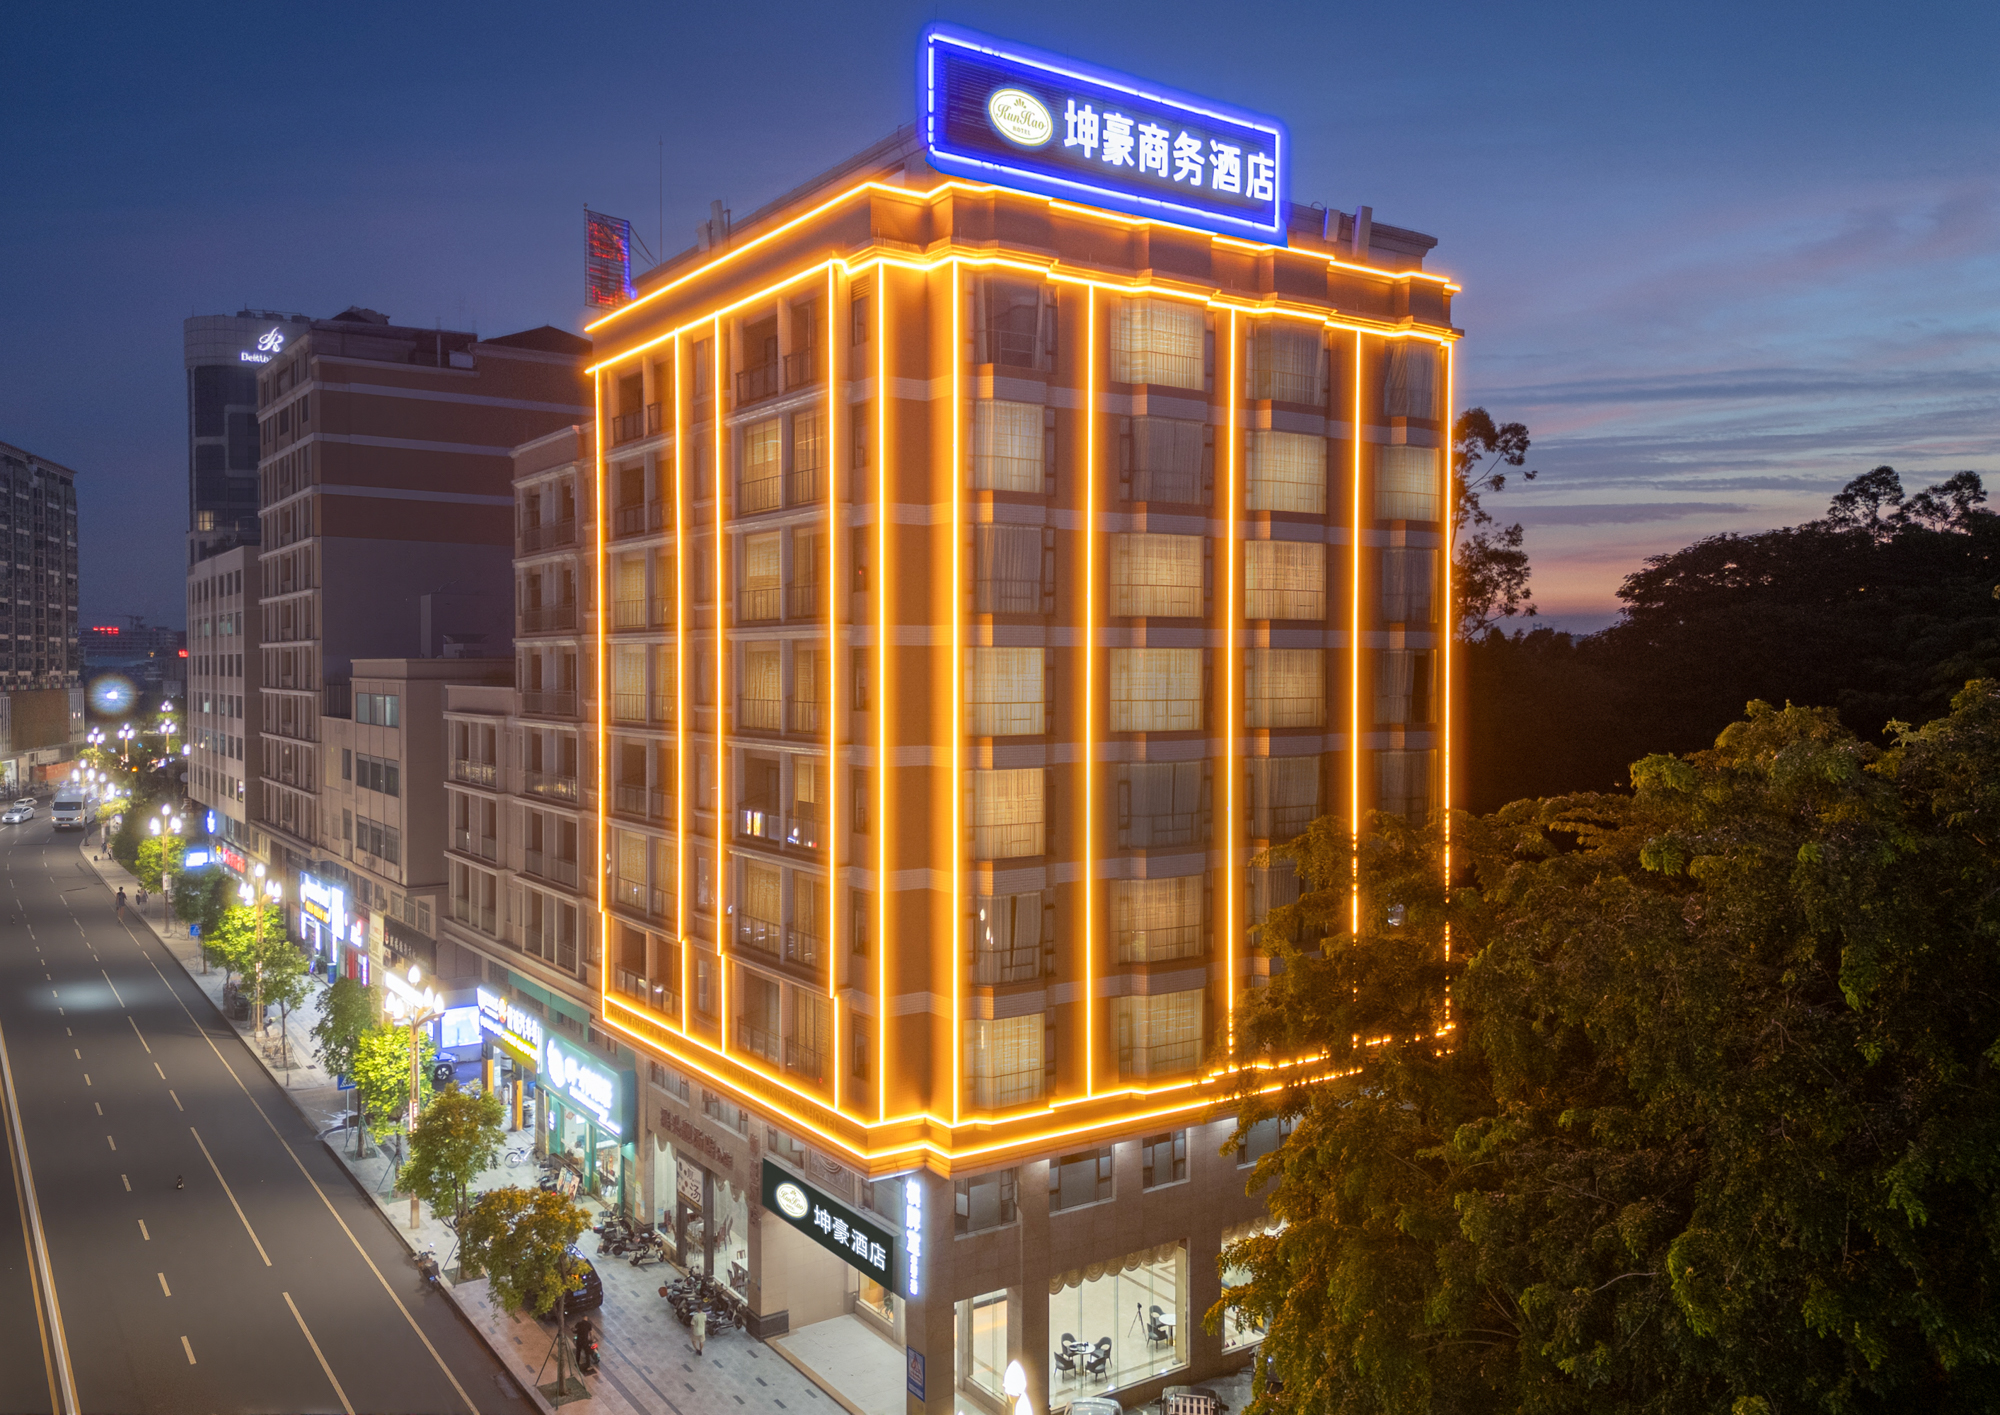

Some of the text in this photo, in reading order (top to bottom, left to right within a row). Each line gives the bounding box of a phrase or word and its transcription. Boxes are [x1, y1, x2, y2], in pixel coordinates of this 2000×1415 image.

[996, 104, 1046, 130] KunHao
[1013, 126, 1031, 135] HOTEL
[1064, 99, 1275, 202] 坤豪商务酒店
[759, 1081, 803, 1116] BUSINESS
[808, 1105, 837, 1133] HOTEL
[813, 1204, 887, 1272] 坤豪酒店
